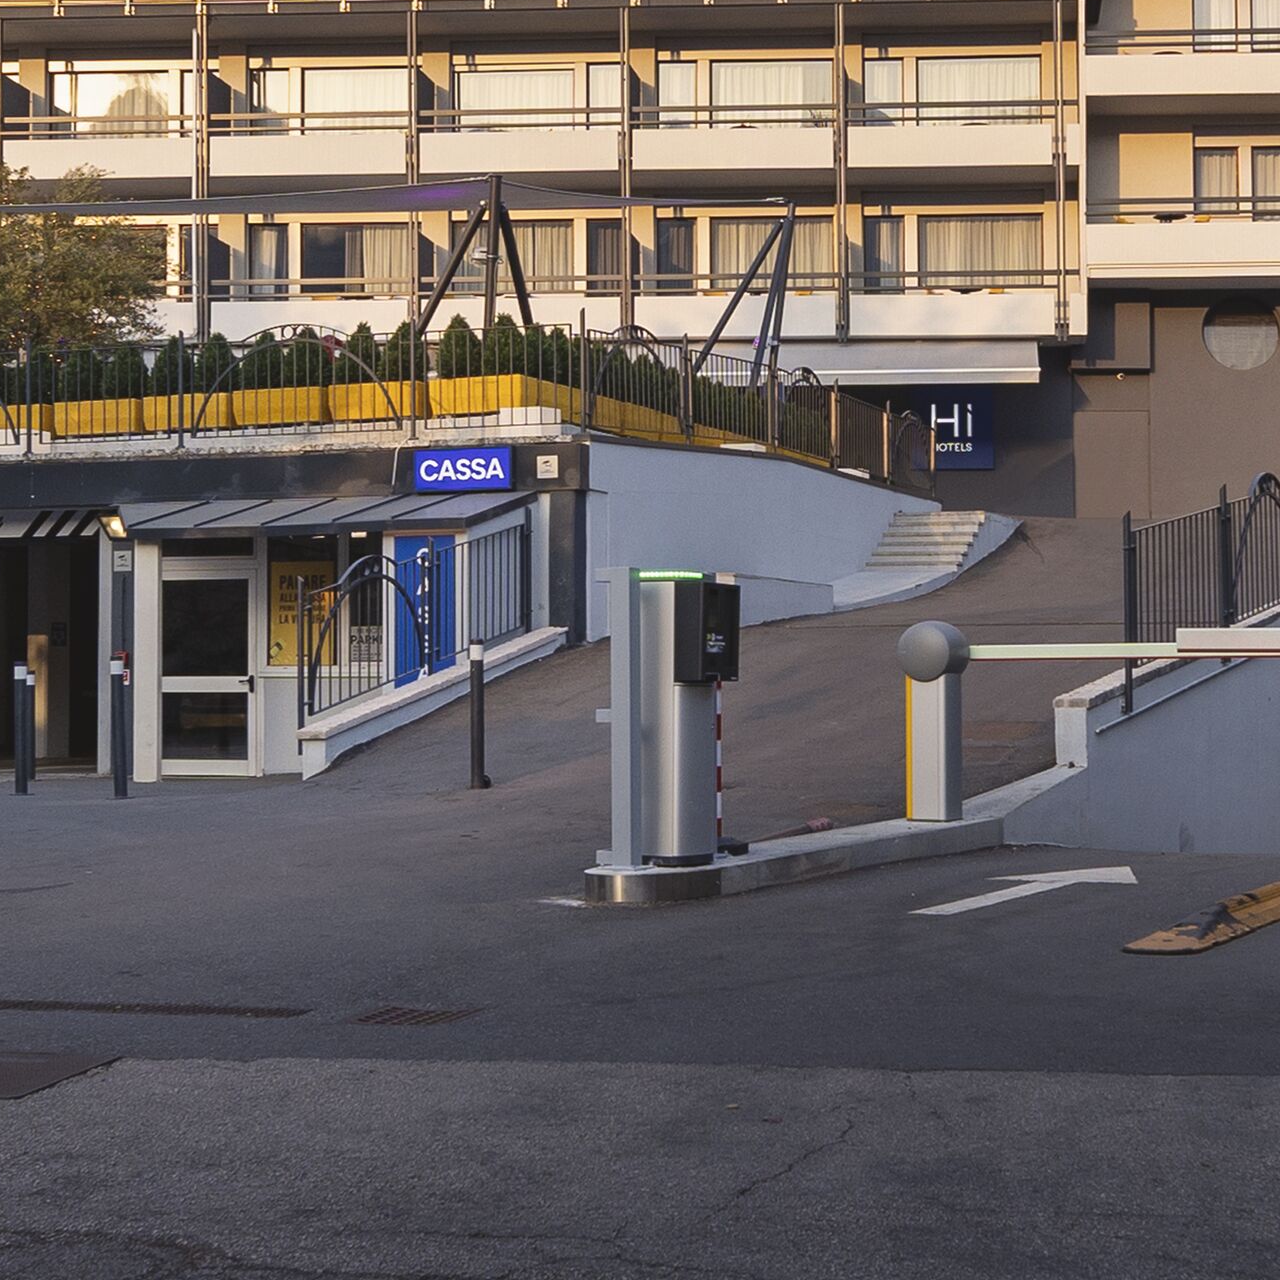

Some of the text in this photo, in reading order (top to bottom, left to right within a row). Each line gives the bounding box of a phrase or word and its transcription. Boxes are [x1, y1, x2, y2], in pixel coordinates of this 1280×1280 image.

[930, 403, 973, 438] Hi
[420, 457, 505, 482] CASSA
[350, 634, 383, 645] PARKI
